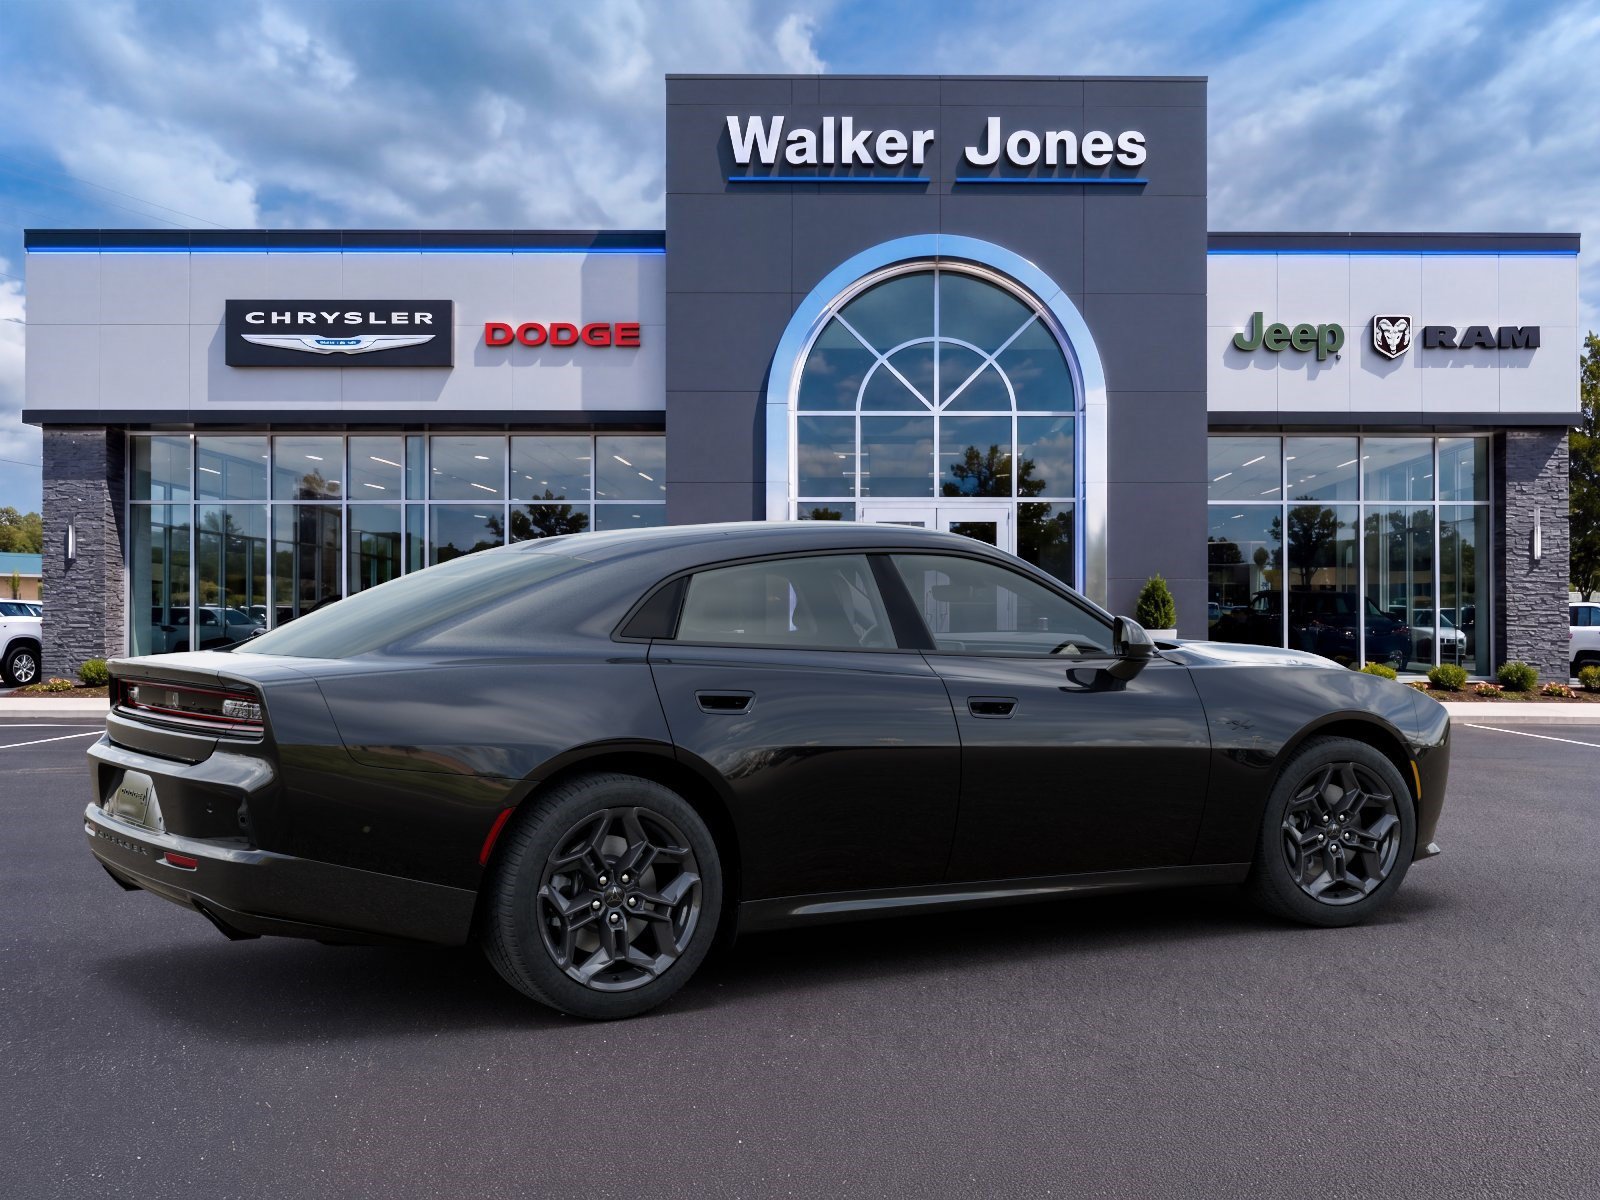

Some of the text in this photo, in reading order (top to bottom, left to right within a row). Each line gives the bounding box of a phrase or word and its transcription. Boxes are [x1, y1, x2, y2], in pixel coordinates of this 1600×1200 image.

[726, 115, 1148, 166] Walker Jones
[245, 311, 433, 325] CHRYSLER
[484, 322, 641, 347] DODGE
[1233, 311, 1345, 361] Jeep
[1423, 325, 1541, 349] RAM
